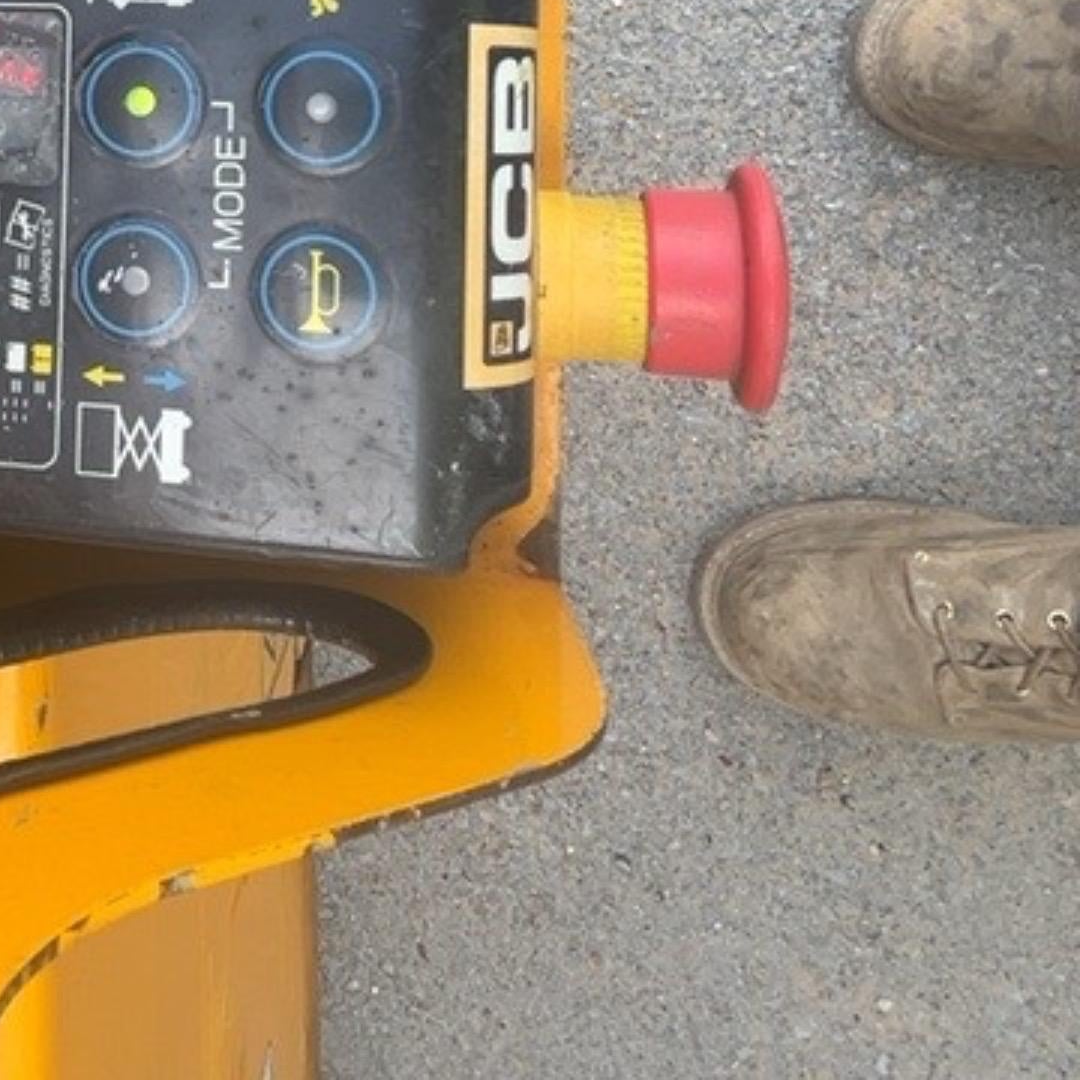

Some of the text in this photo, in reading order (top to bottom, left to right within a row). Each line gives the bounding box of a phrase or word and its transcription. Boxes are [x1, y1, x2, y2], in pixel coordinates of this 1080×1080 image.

[212, 135, 247, 252] MODE
[491, 56, 536, 354] JCB
[37, 218, 54, 307] DIAGNOSTICS
